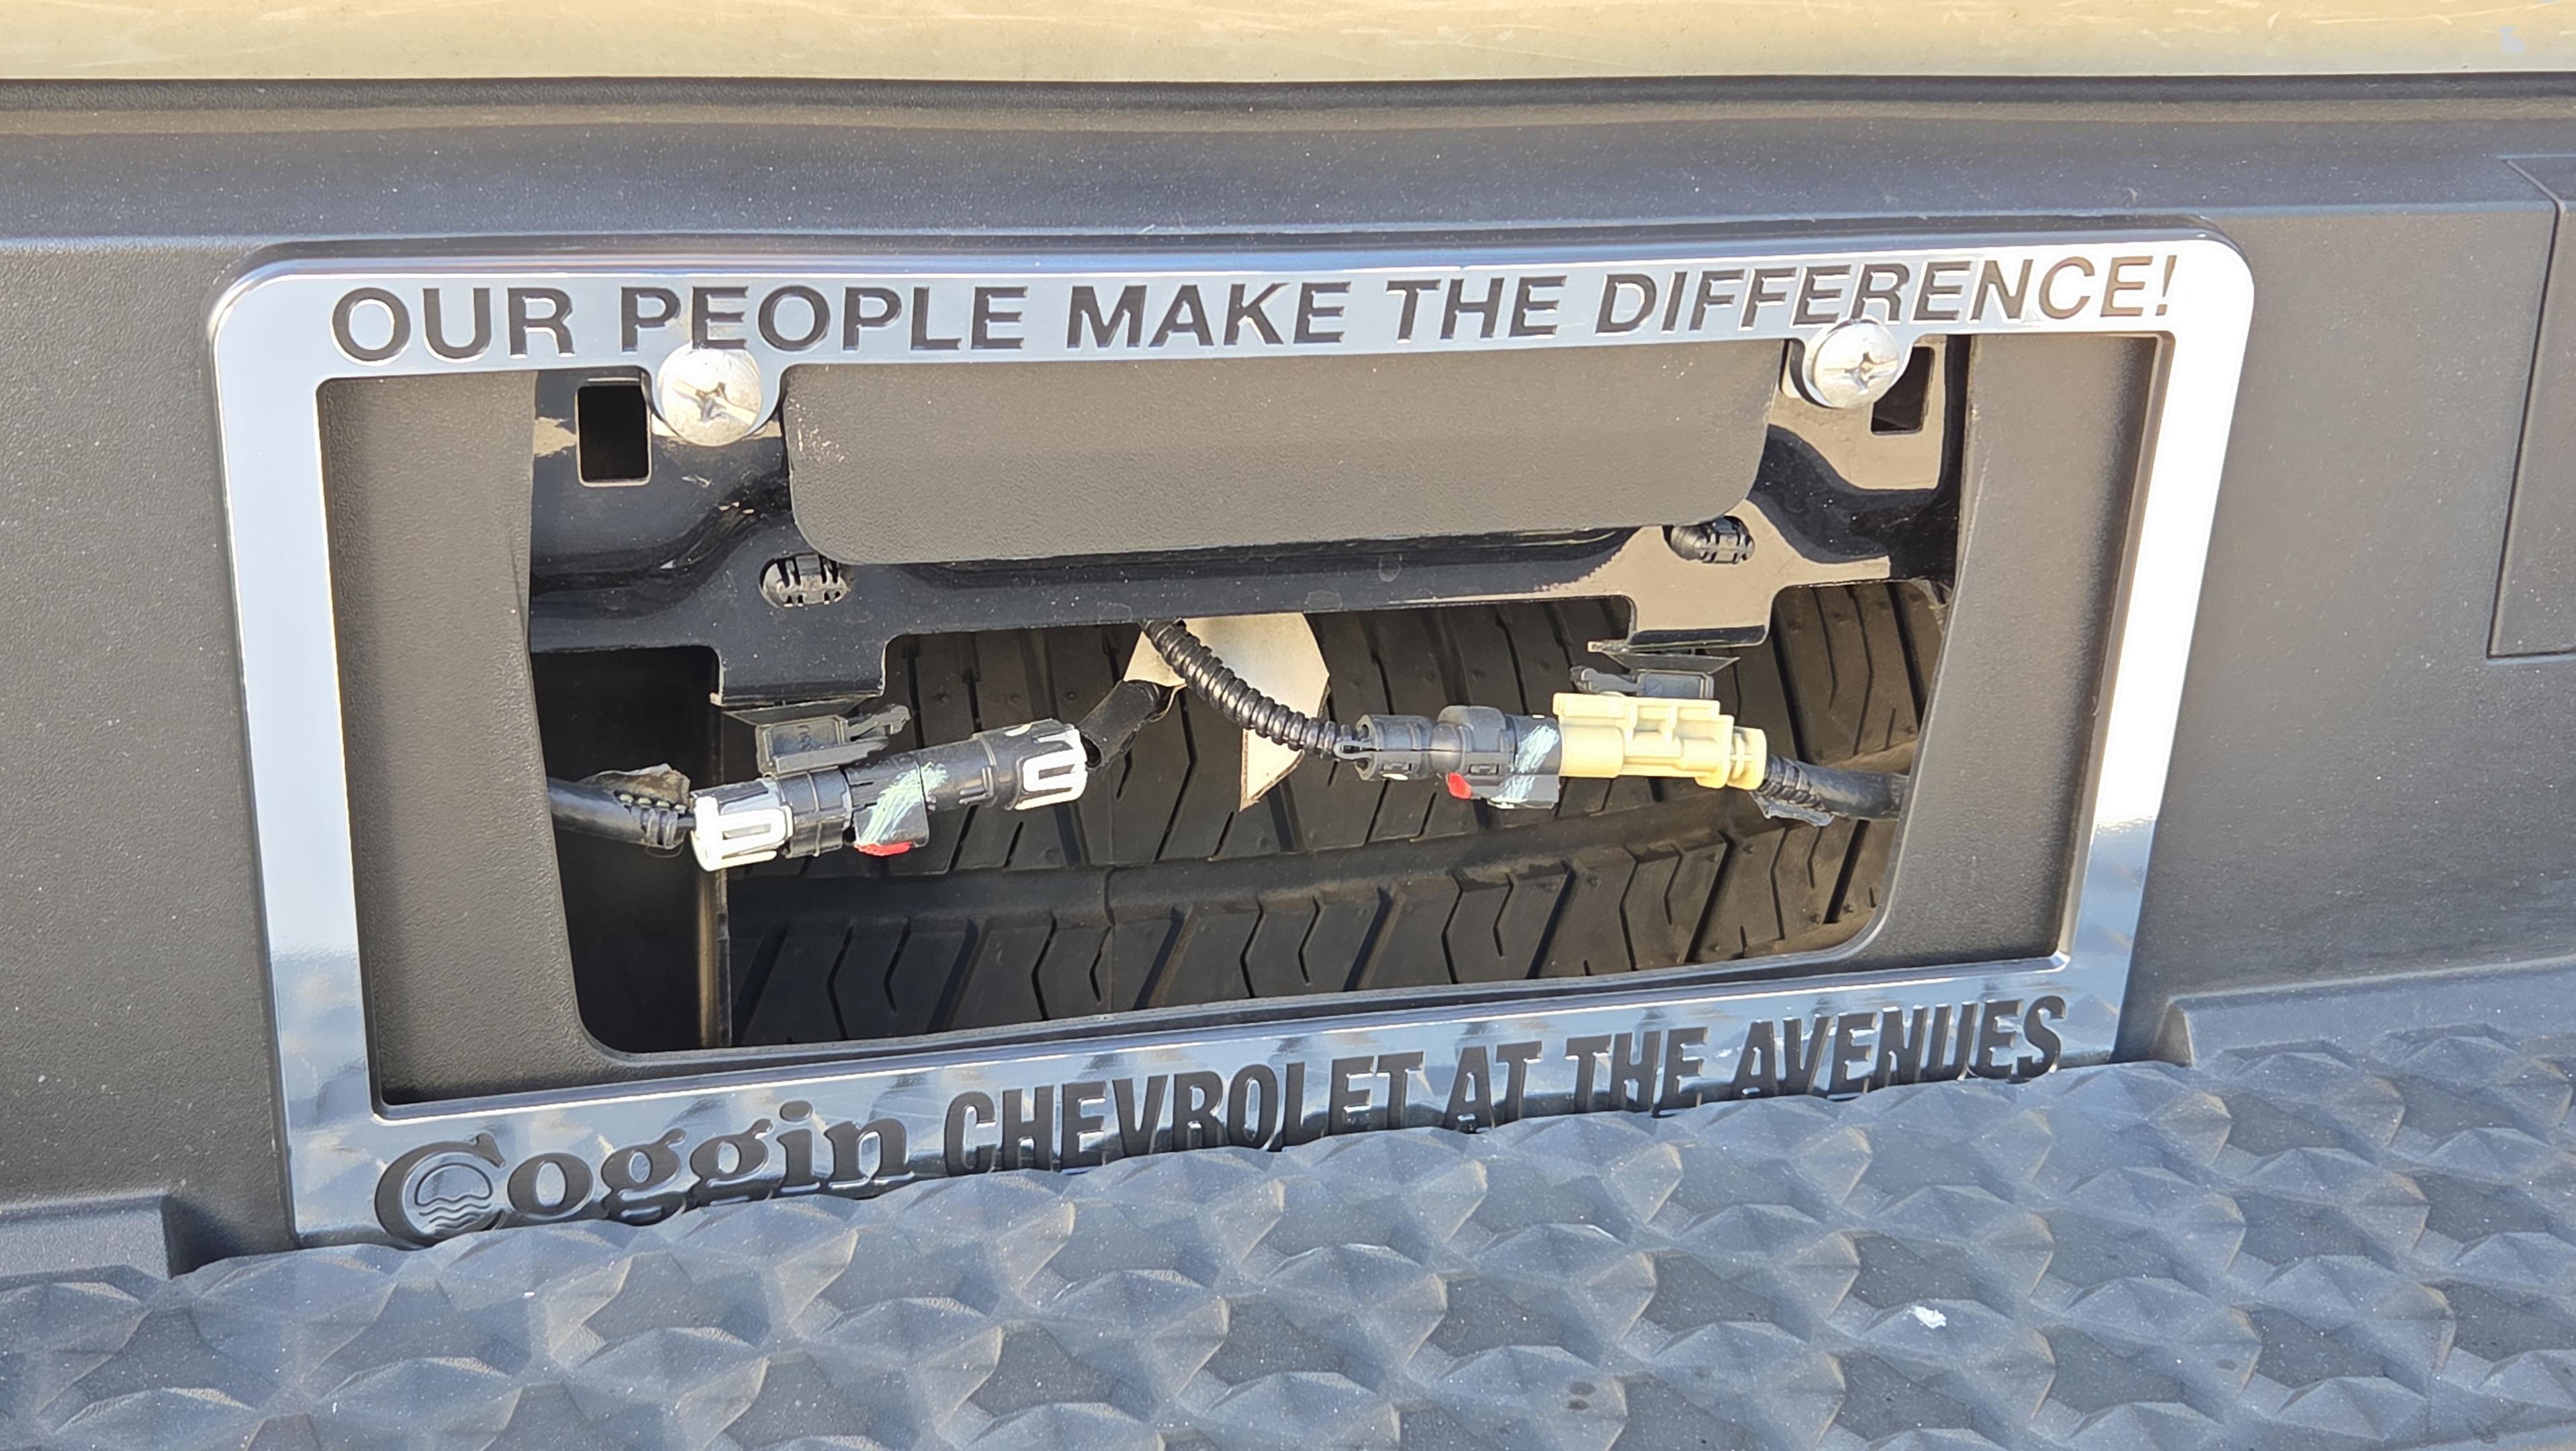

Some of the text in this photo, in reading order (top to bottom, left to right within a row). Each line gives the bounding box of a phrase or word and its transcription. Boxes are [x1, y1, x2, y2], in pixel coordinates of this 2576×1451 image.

[330, 254, 2178, 364] OUR PEOPLE MAKE THE DIFFERENCE!
[373, 995, 2067, 1247] Coggin CHEVROLET AT THE AVENUES
